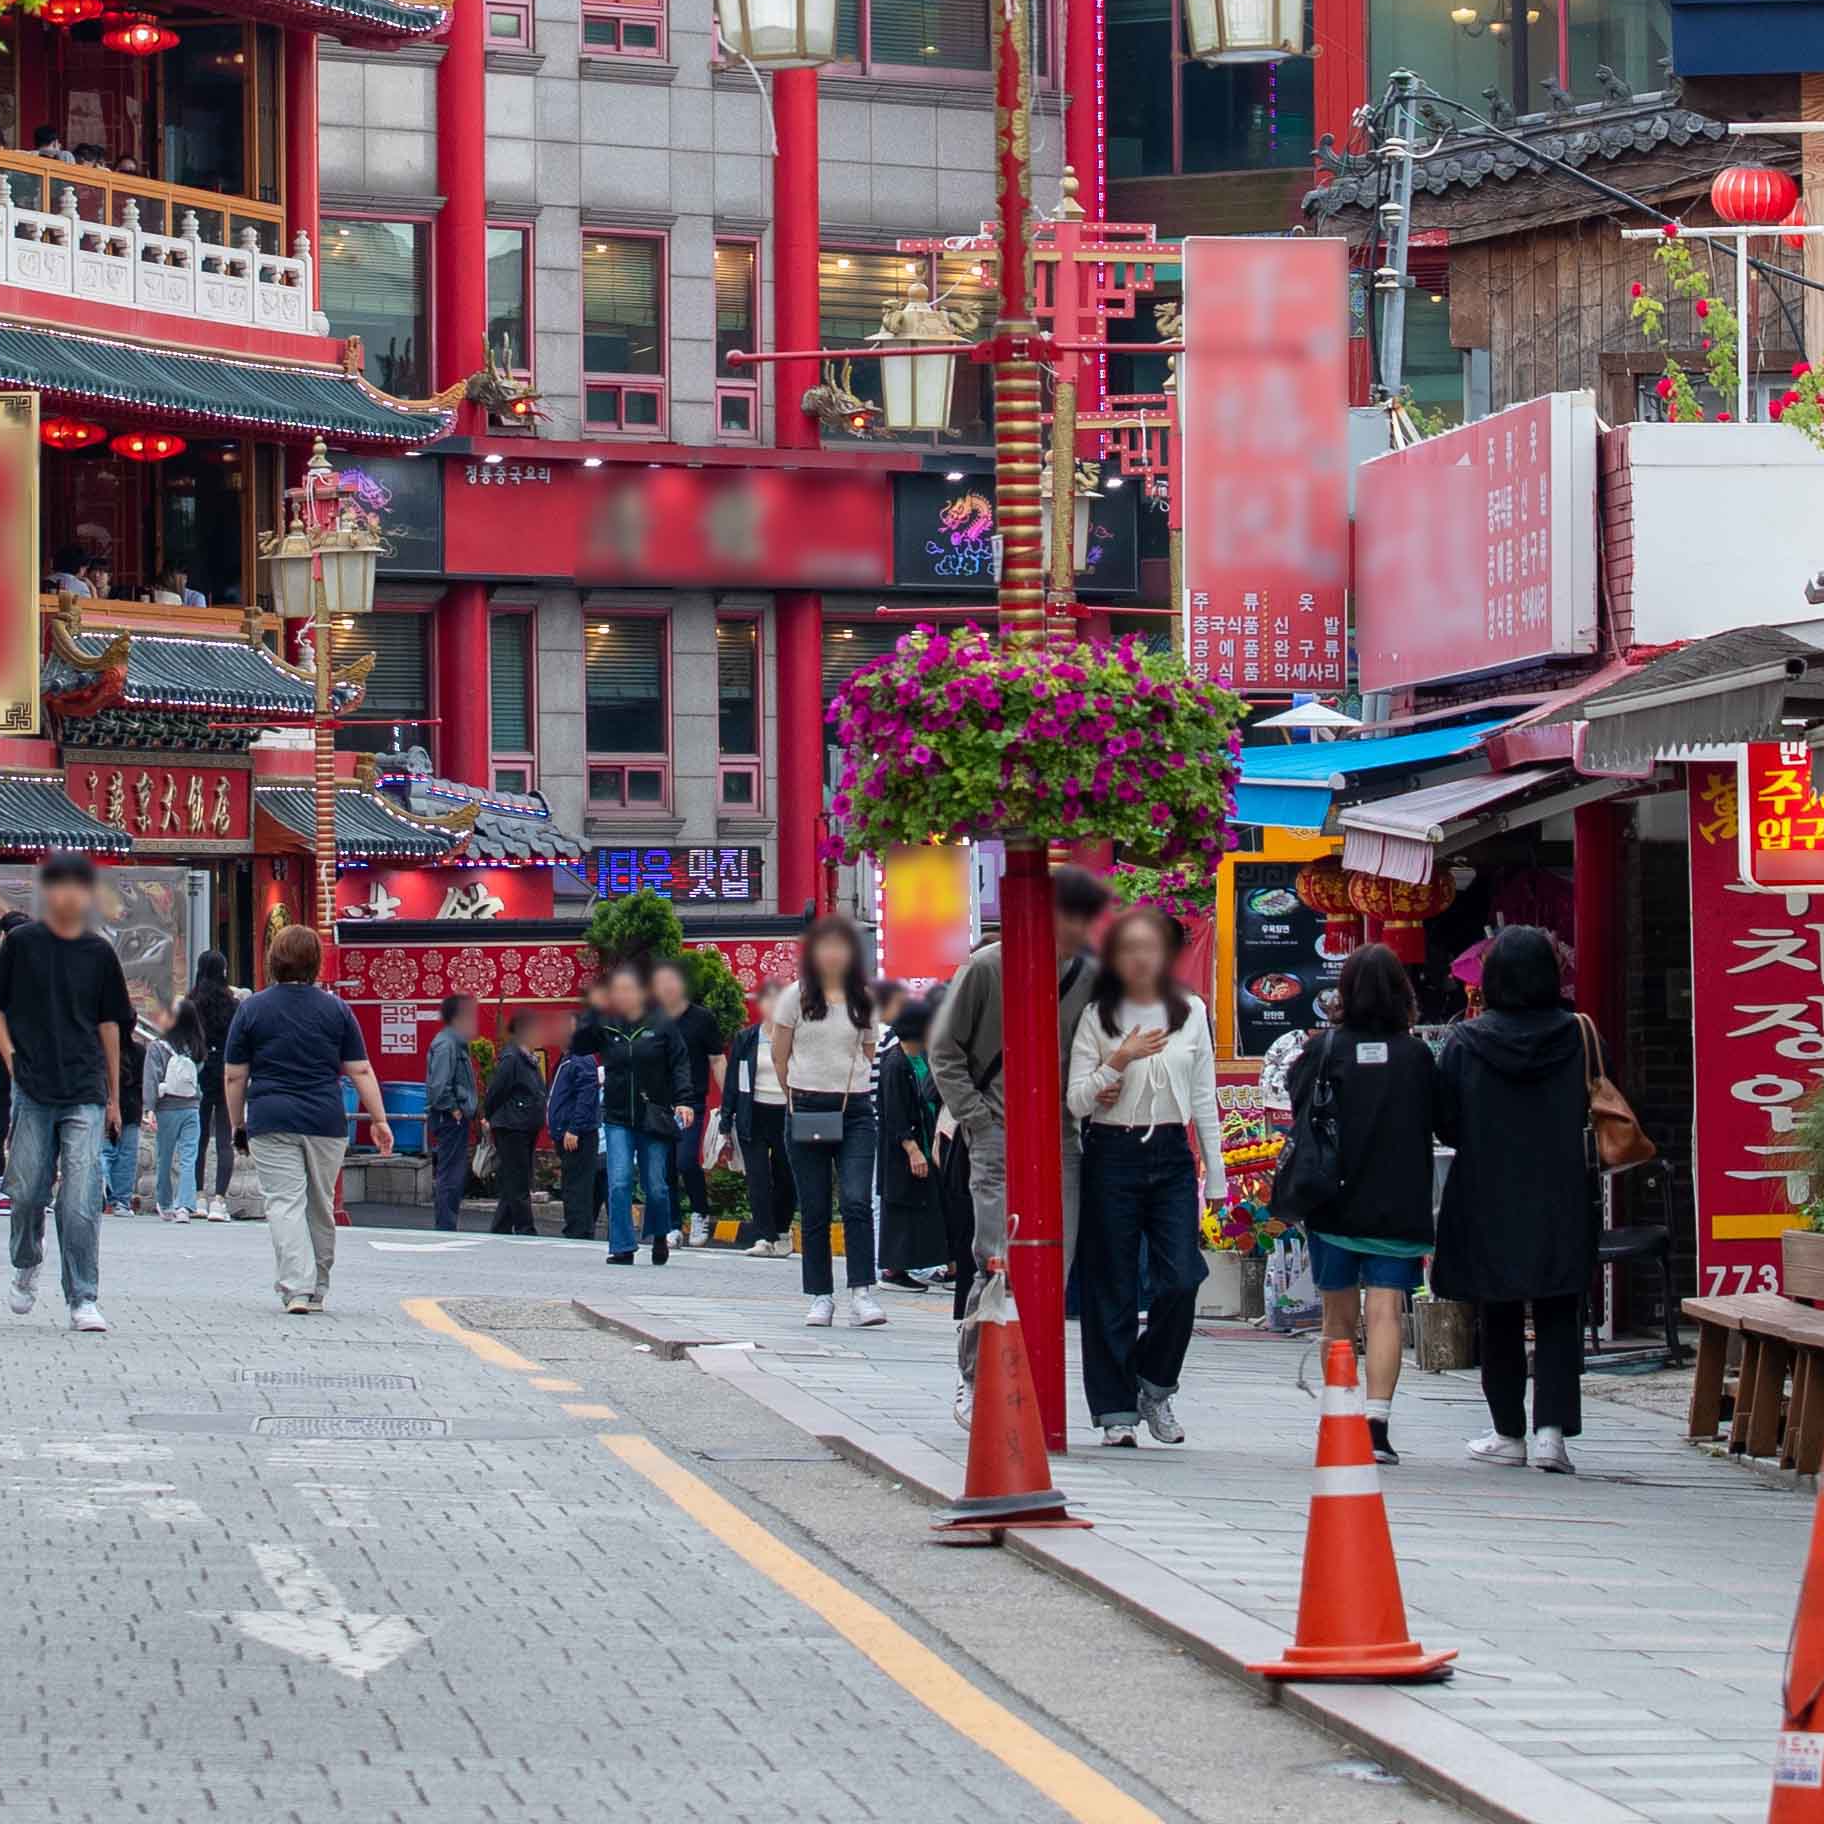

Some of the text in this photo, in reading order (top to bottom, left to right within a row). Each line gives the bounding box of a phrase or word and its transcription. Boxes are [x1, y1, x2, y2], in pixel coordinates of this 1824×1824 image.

[1193, 616, 1261, 636] 중국식품
[1274, 662, 1340, 683] 악세사리
[687, 848, 749, 898] 맛집
[382, 1005, 417, 1025] 금연
[381, 1033, 416, 1052] 구역
